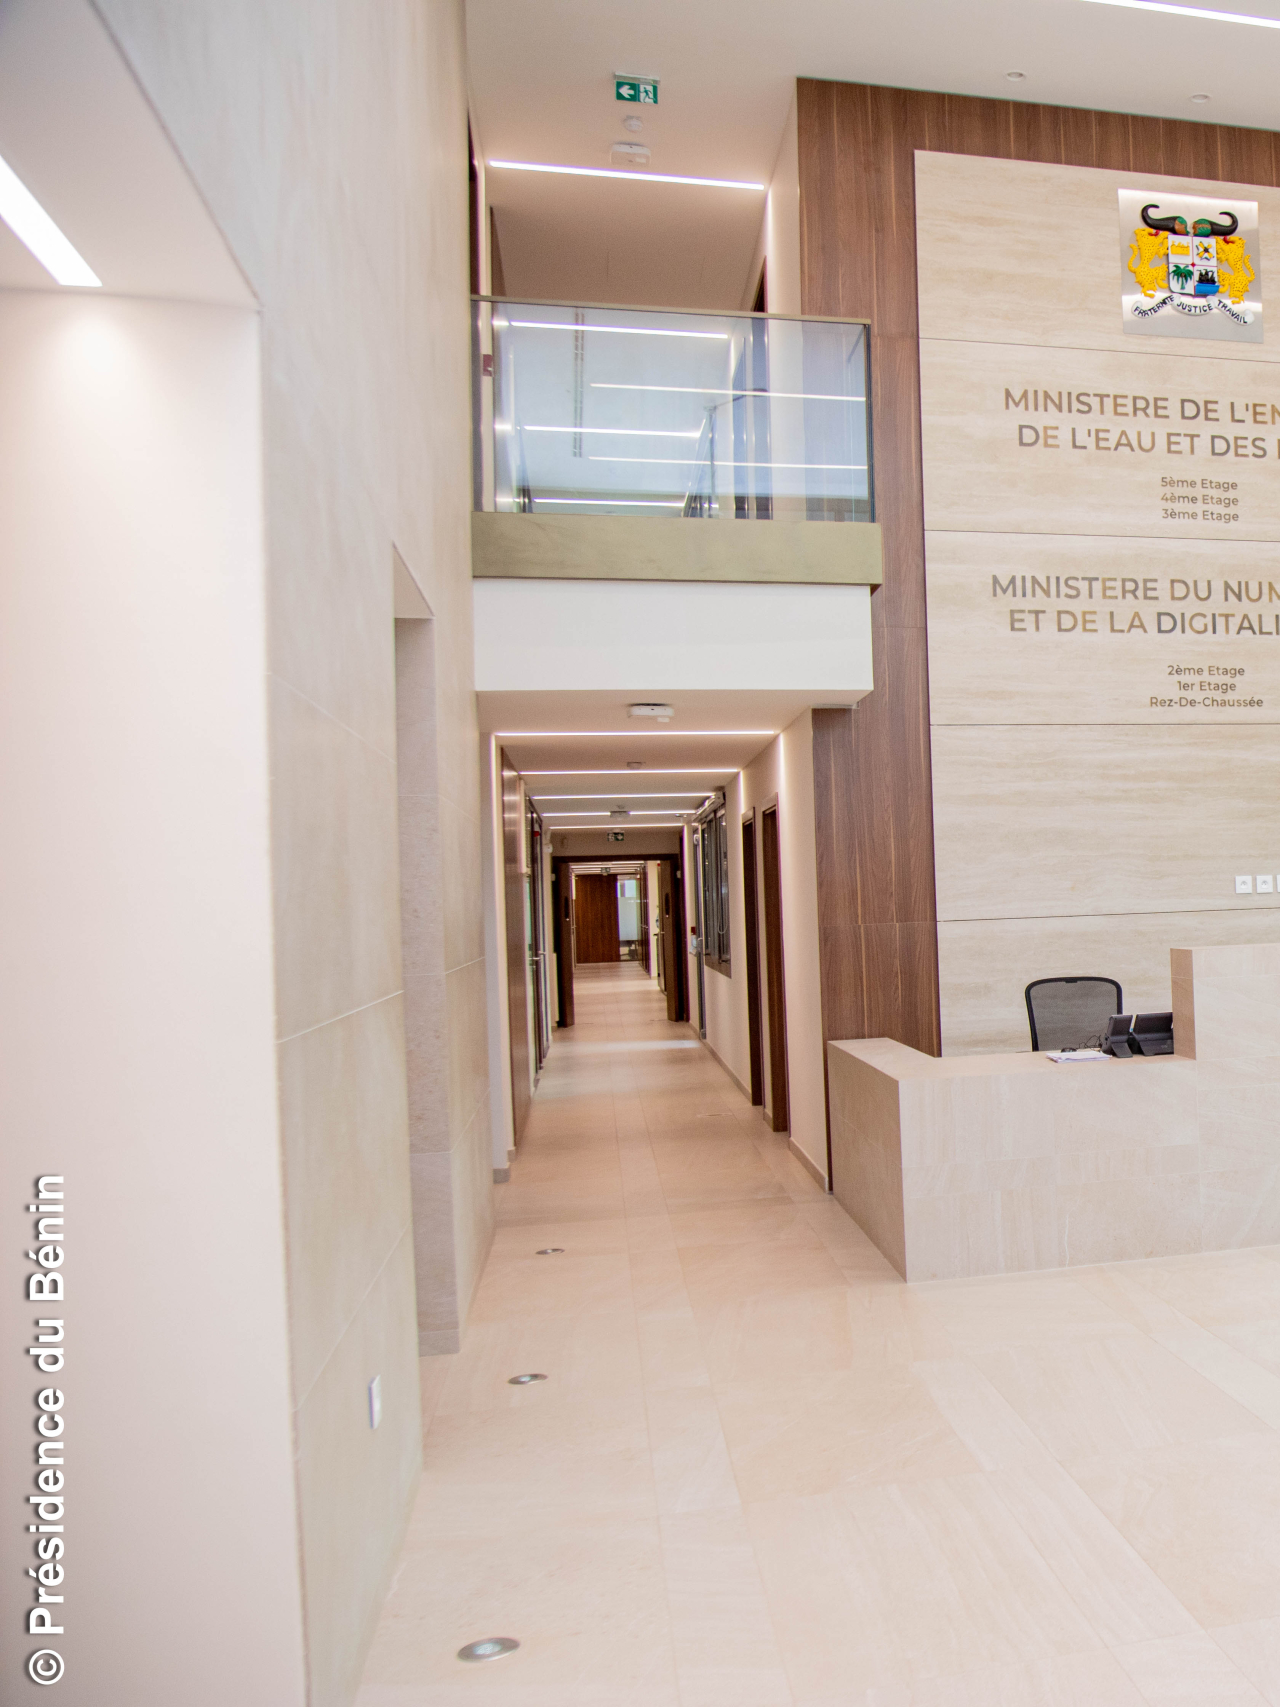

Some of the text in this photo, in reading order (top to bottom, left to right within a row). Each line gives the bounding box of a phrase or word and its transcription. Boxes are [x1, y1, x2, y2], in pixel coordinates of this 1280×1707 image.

[1176, 300, 1214, 314] JUSTICE
[1217, 299, 1249, 325] TRAVAIL
[1004, 387, 1170, 420] MINISTERE
[1179, 398, 1220, 423] DE
[1018, 424, 1060, 449] DE
[1071, 427, 1156, 454] L'EAU
[1166, 432, 1201, 456] ET
[1210, 434, 1268, 459] DES
[1160, 476, 1239, 492] 5ème Etage
[1160, 492, 1240, 508] 4ème Etage
[1161, 507, 1240, 524] 3ème Etage
[991, 574, 1160, 601] MINISTERE
[1169, 578, 1213, 602] DU
[1009, 608, 1047, 633] ET
[1056, 609, 1099, 633] DE
[1109, 610, 1149, 634] LA
[1167, 664, 1246, 680] 2ème Etage
[1176, 680, 1237, 695] 1er Etage
[1149, 695, 1264, 709] Rez-De-Chaussée
